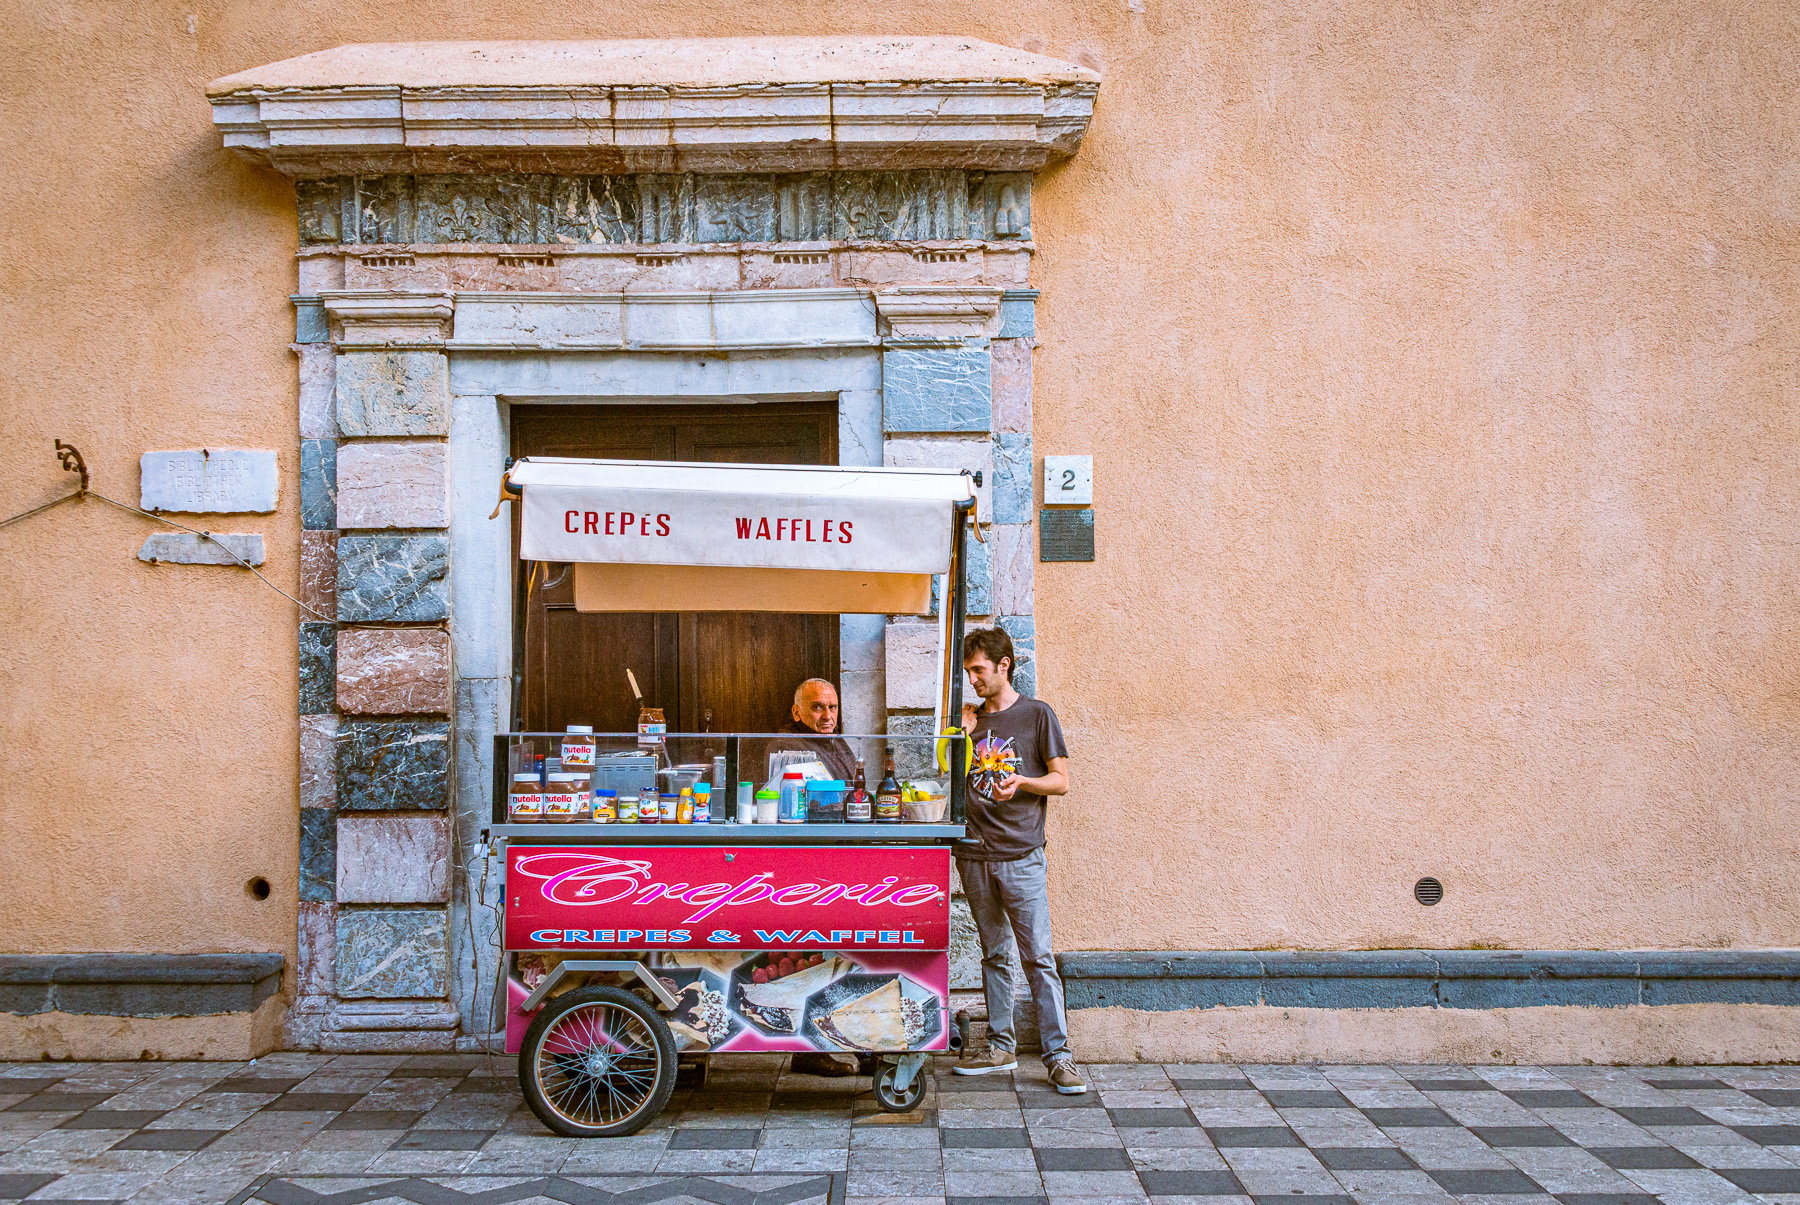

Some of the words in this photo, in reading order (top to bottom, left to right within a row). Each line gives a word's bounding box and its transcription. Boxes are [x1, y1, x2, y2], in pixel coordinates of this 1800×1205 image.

[1061, 469, 1076, 491] 2
[187, 490, 235, 503] LIBRARY
[735, 517, 854, 544] WAFFLES
[563, 746, 591, 754] nutella
[512, 794, 541, 803] nutella
[545, 794, 572, 803] nutella
[515, 852, 942, 925] Creperie
[530, 929, 691, 943] CREPES
[707, 929, 740, 943] &
[753, 929, 925, 944] WAFFEL
